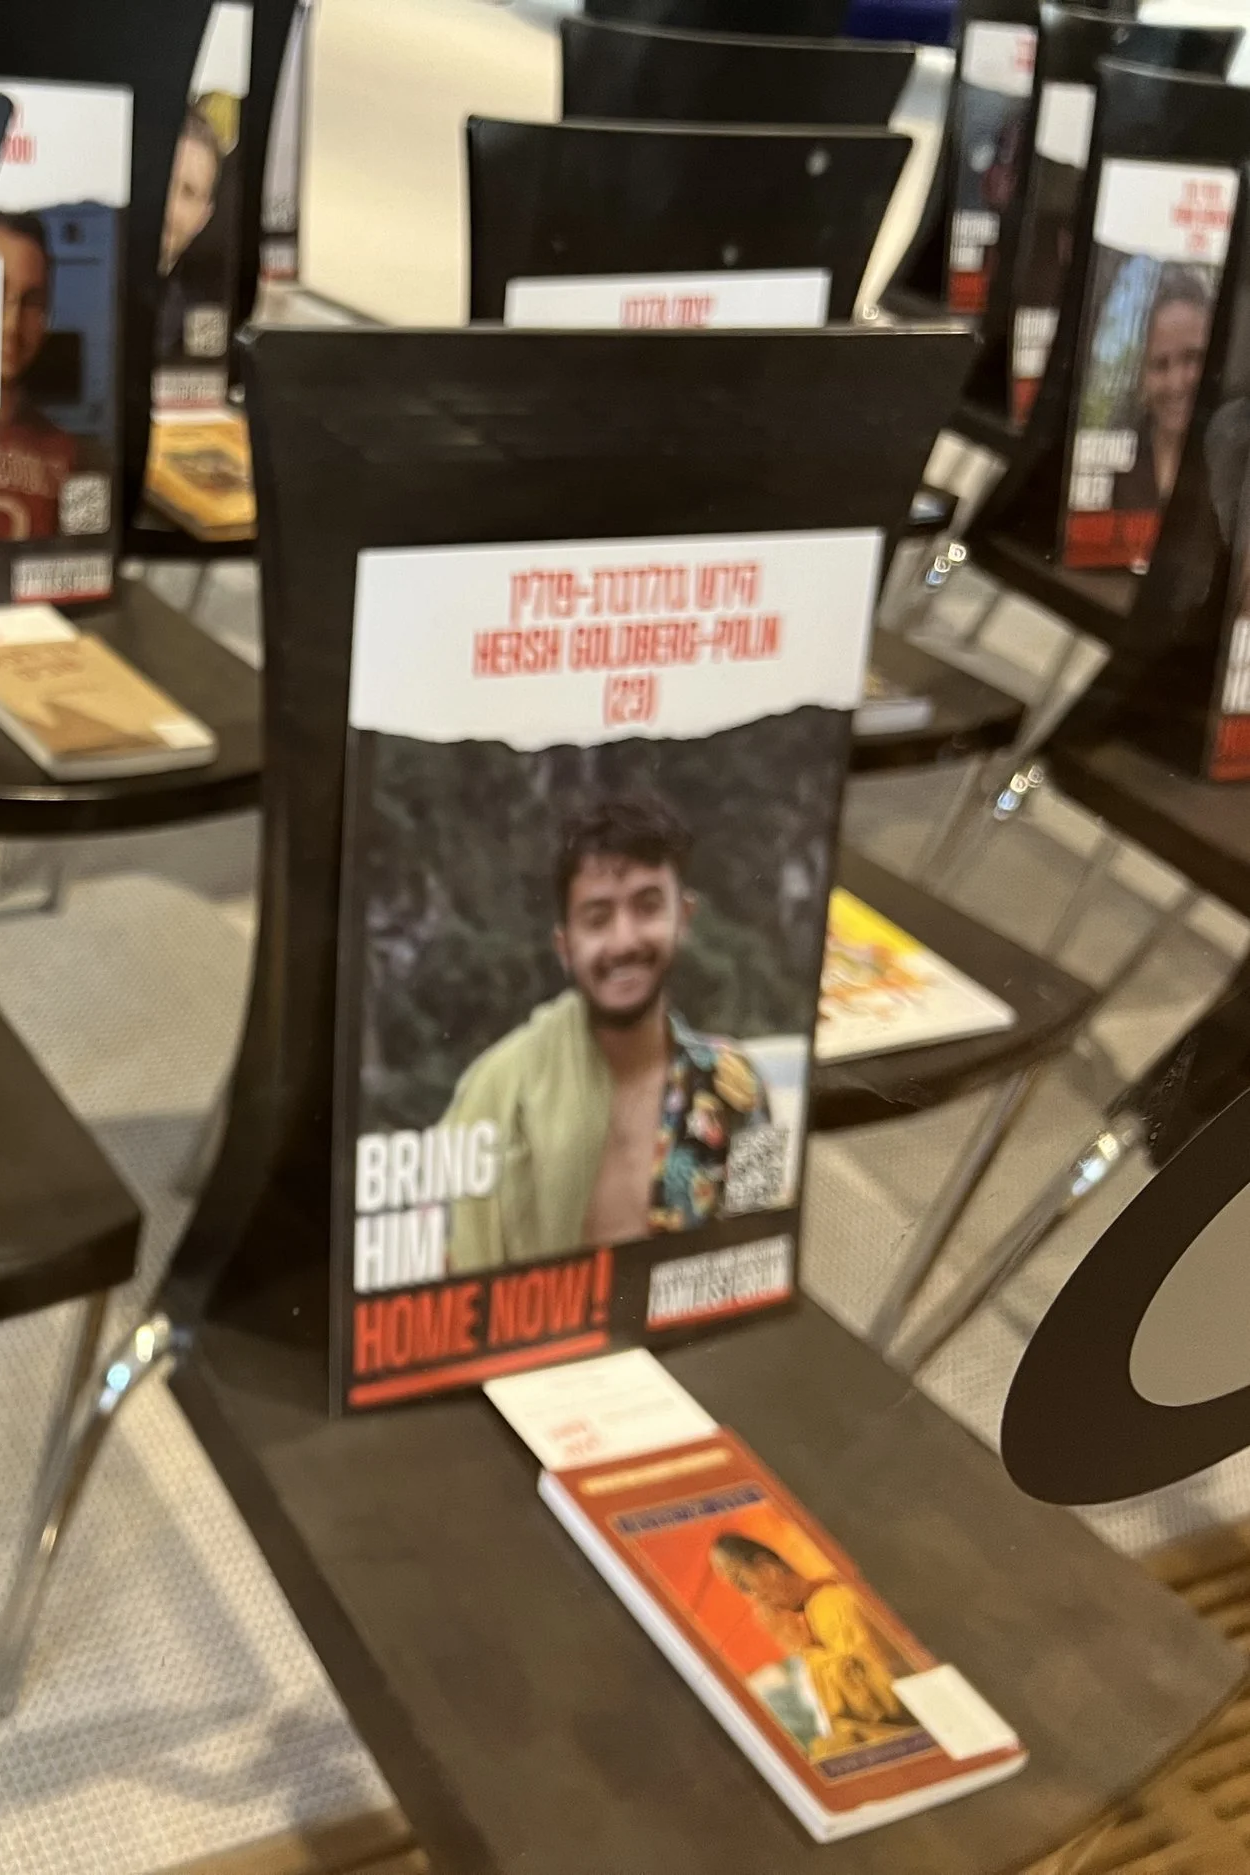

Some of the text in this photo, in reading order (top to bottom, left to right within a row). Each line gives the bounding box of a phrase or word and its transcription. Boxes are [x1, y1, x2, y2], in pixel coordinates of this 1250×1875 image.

[472, 610, 783, 679] HERSH GOLDBERG-POLIN
[356, 1119, 497, 1213] BRING
[353, 1205, 446, 1294] HIM
[353, 1282, 482, 1374] HOME
[488, 1246, 613, 1347] NOW!
